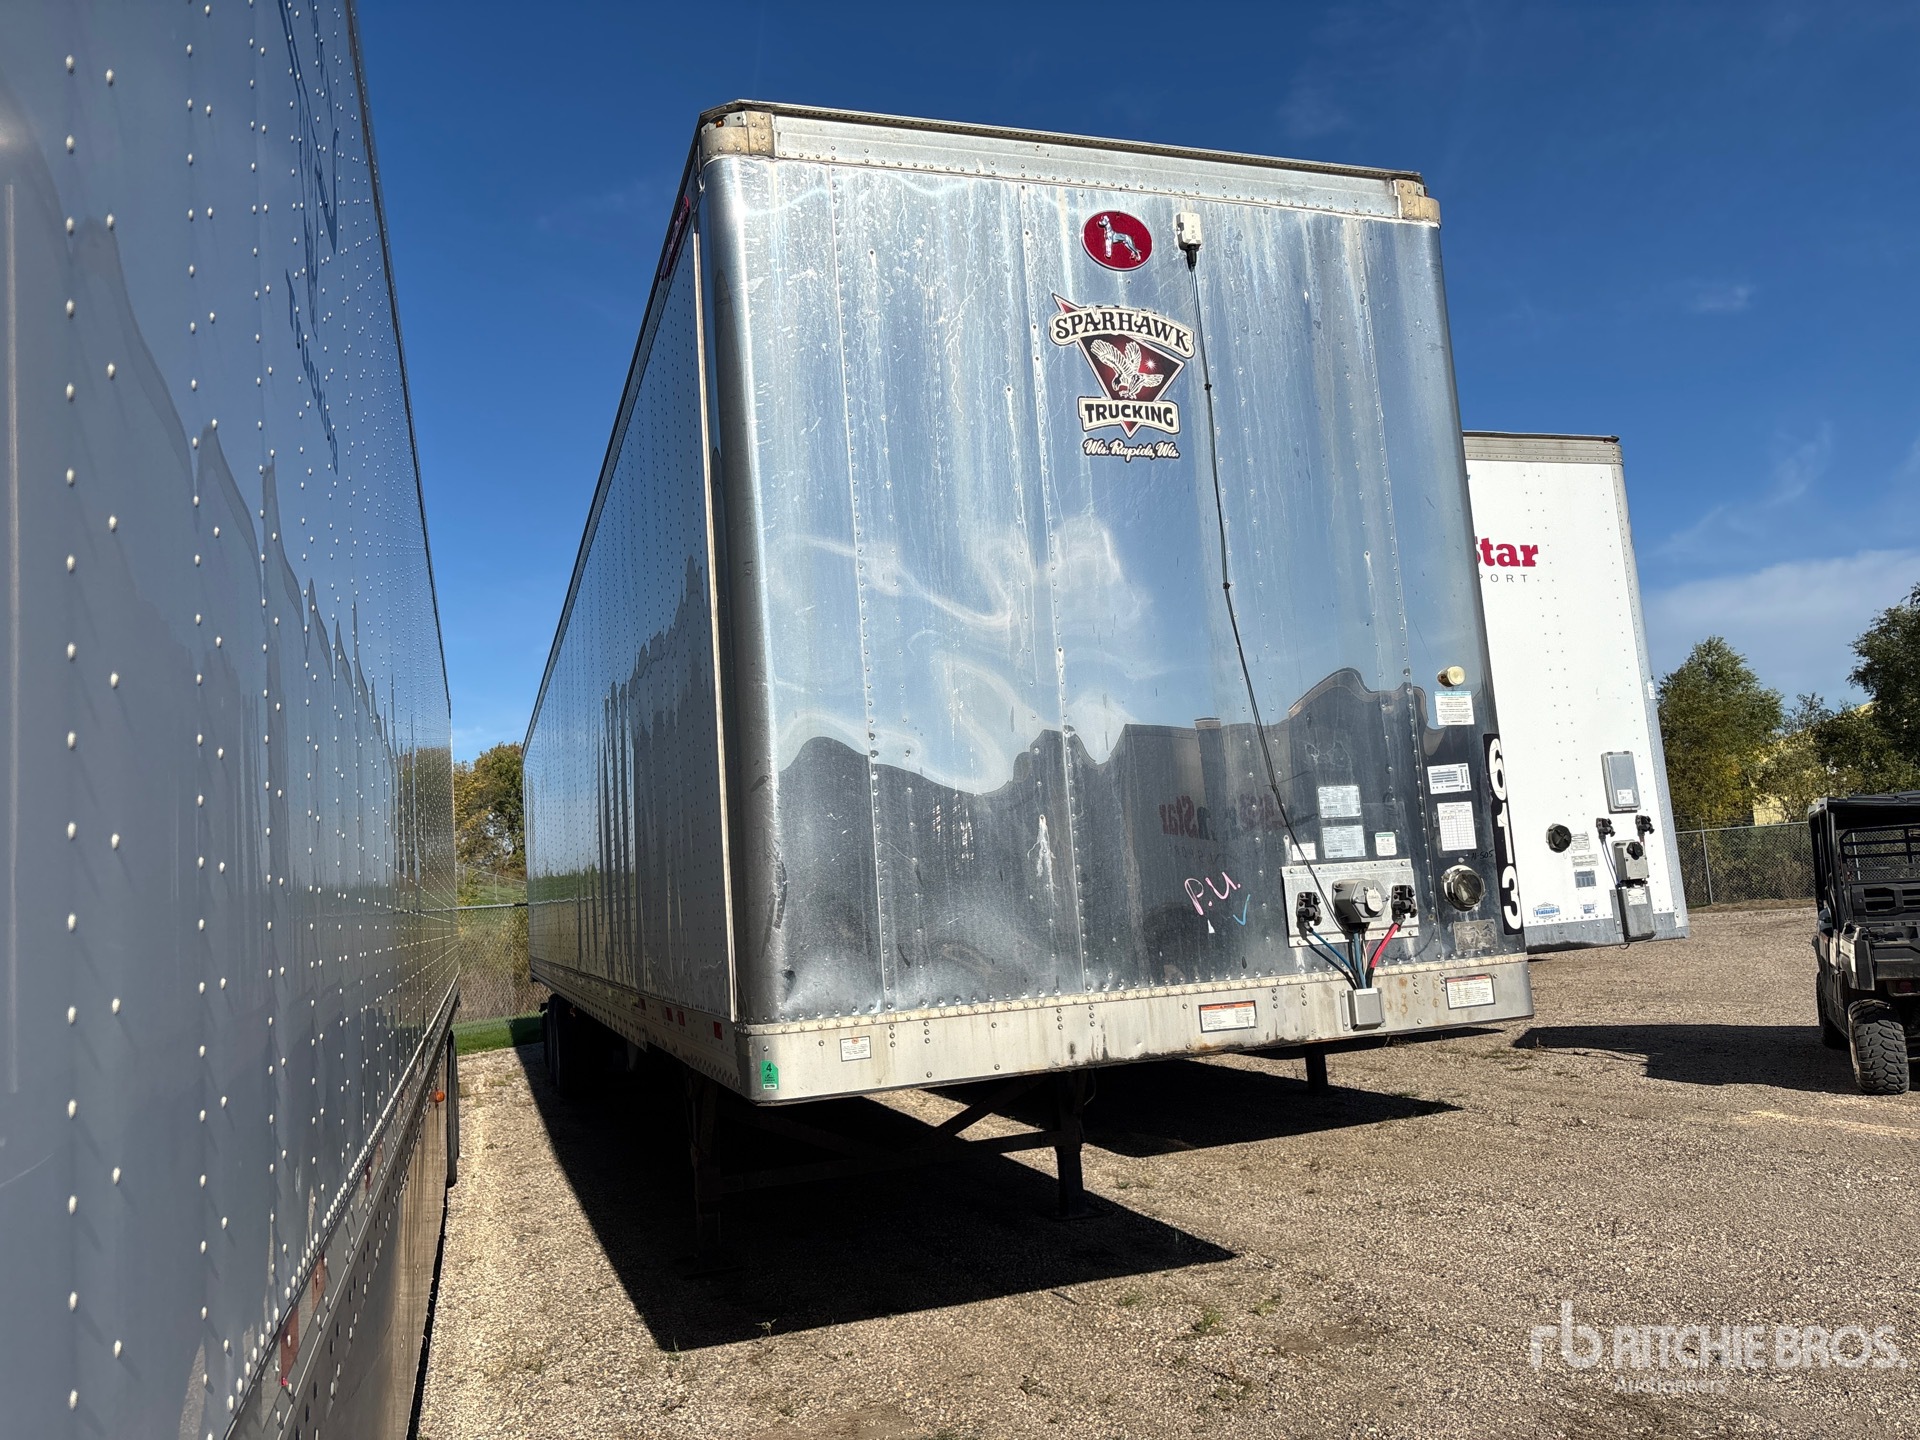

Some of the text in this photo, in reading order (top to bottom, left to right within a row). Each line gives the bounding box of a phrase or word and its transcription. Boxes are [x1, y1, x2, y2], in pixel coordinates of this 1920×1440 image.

[1055, 311, 1190, 352] SPARHAWK
[285, 268, 339, 475] Trucking
[1084, 403, 1174, 428] TRUCKING
[1084, 440, 1109, 455] Wis.
[1156, 442, 1179, 458] Wis.
[1475, 536, 1539, 567] tar
[1489, 738, 1522, 930] 613
[766, 1063, 773, 1072] 4
